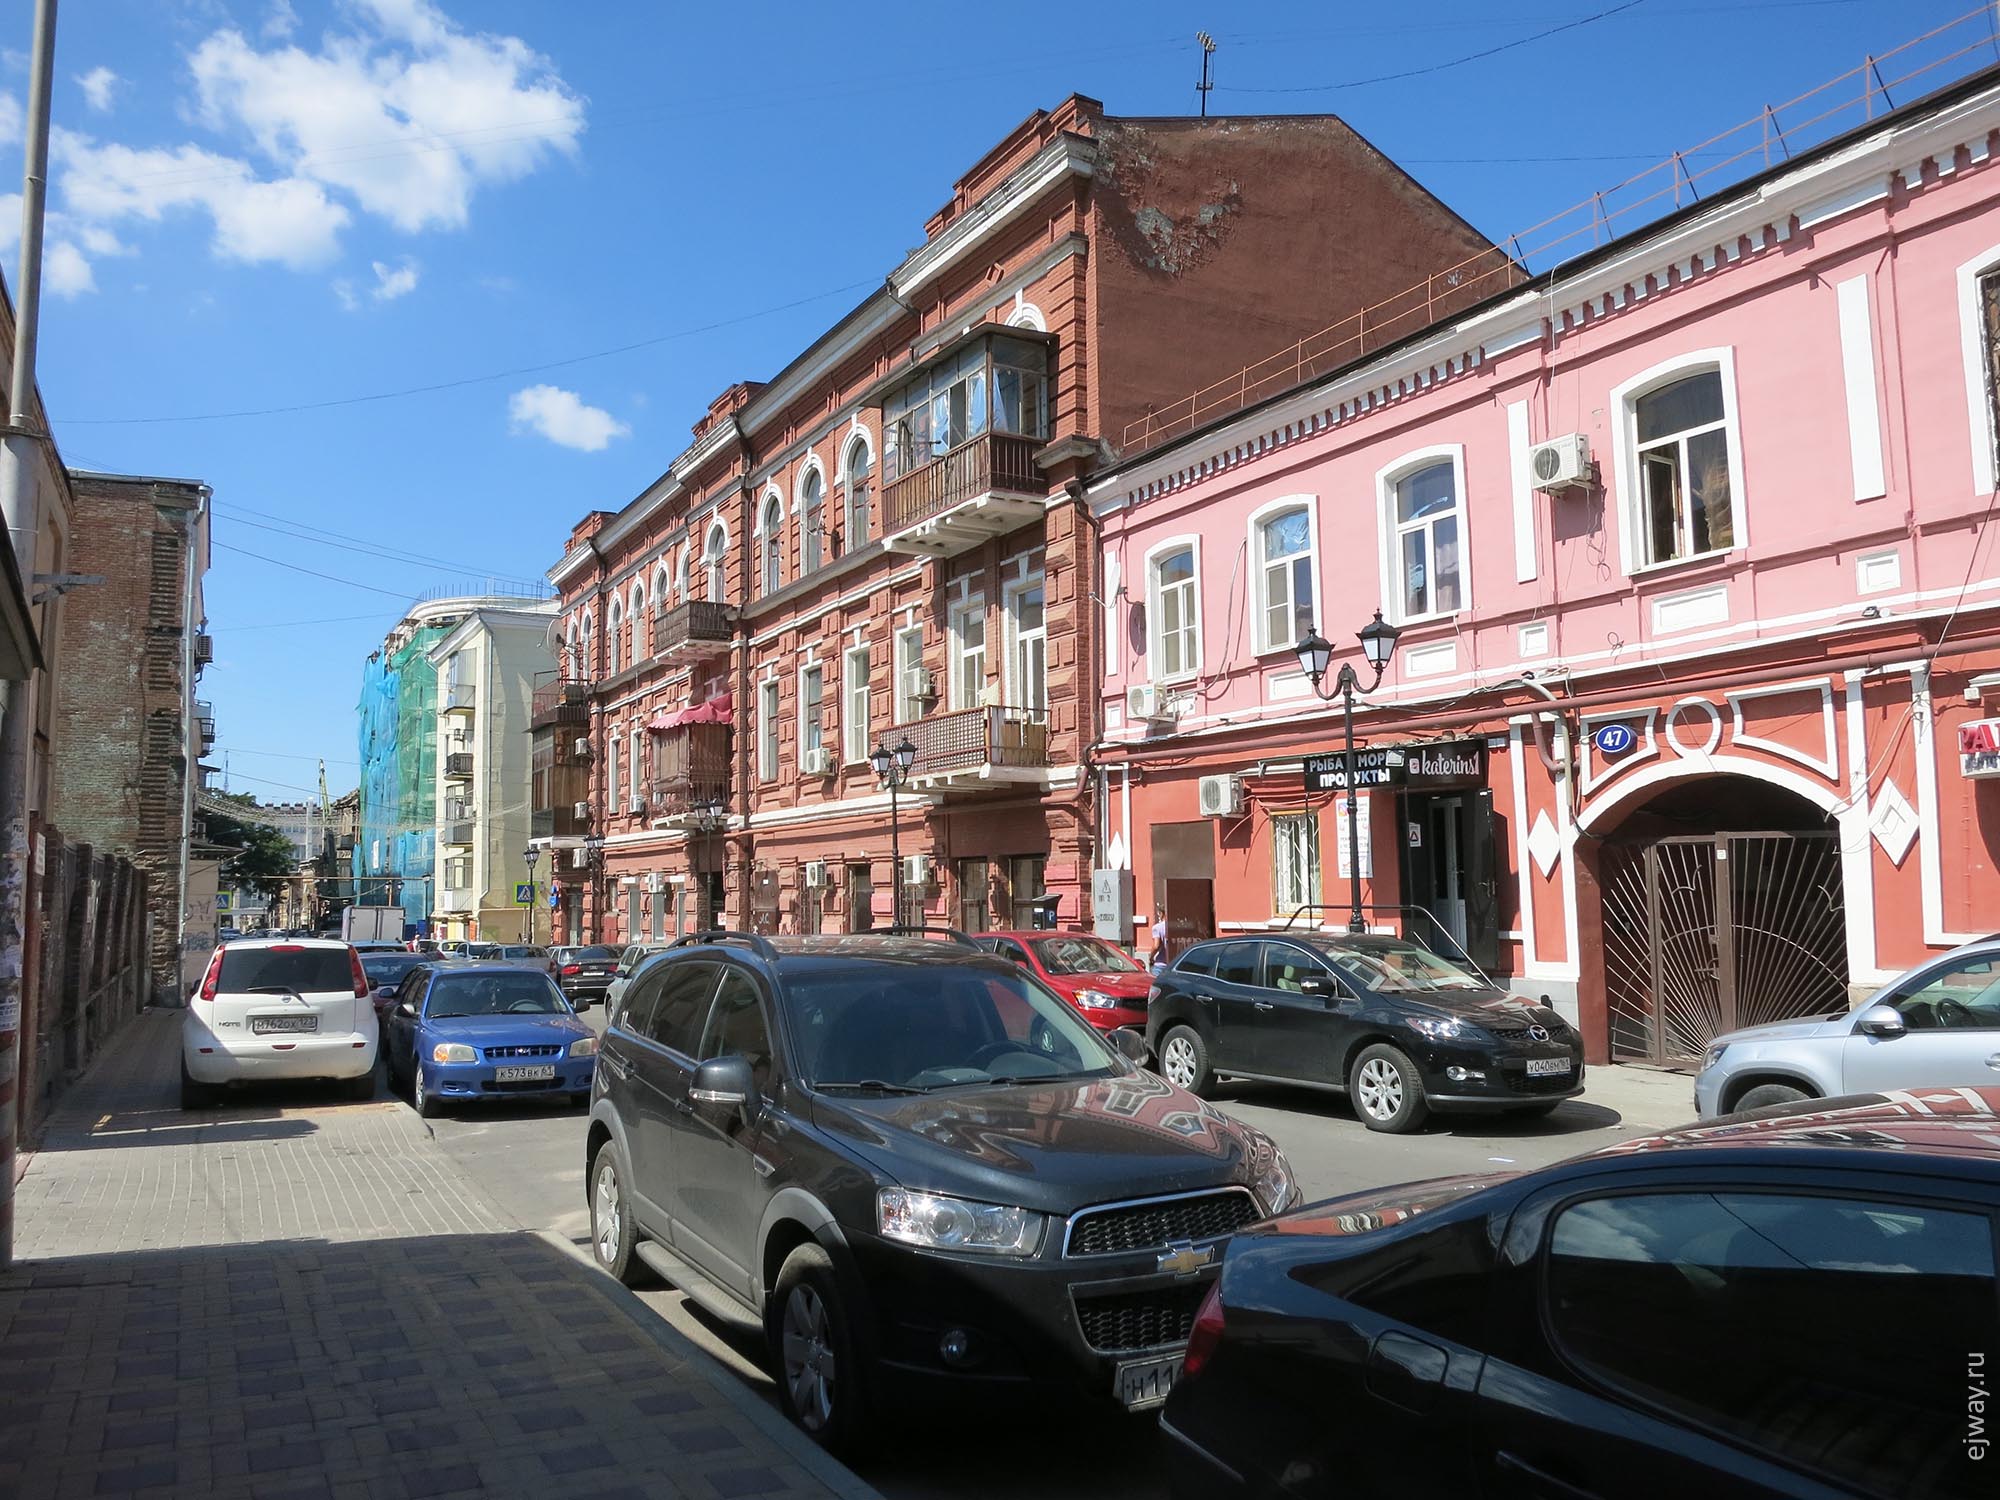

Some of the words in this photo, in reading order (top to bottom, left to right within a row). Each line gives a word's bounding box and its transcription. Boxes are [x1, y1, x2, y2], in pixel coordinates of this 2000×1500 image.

[1602, 729, 1623, 747] 47
[1959, 724, 2000, 754] РА
[1309, 757, 1344, 773] РЫБА
[1357, 752, 1387, 768] МОР
